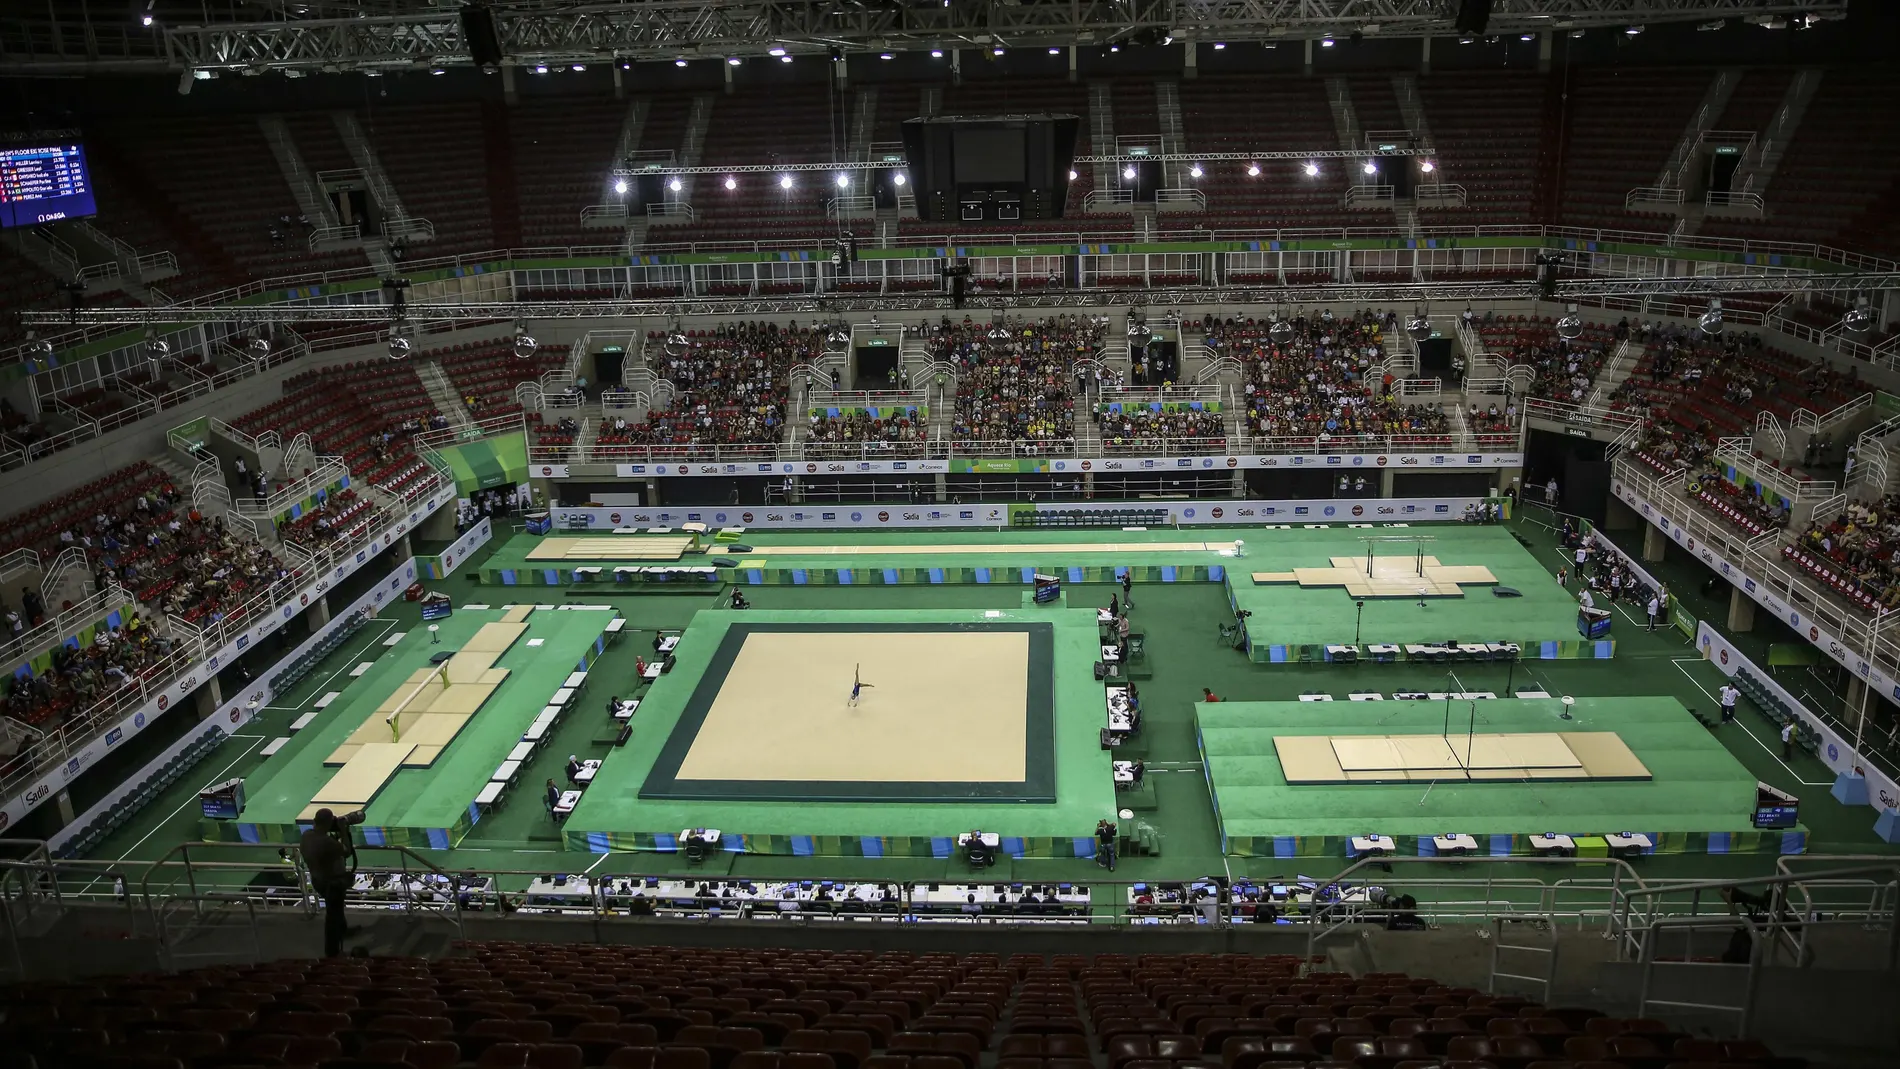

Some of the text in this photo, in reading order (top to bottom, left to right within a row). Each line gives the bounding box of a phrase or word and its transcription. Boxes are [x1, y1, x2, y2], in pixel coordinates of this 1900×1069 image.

[1260, 458, 1276, 466] Sadia
[1401, 456, 1418, 465] Sadia
[701, 466, 718, 474] Sadia
[828, 463, 844, 472] Sadia
[180, 676, 197, 693] Sadia
[26, 785, 49, 806] Sadia
